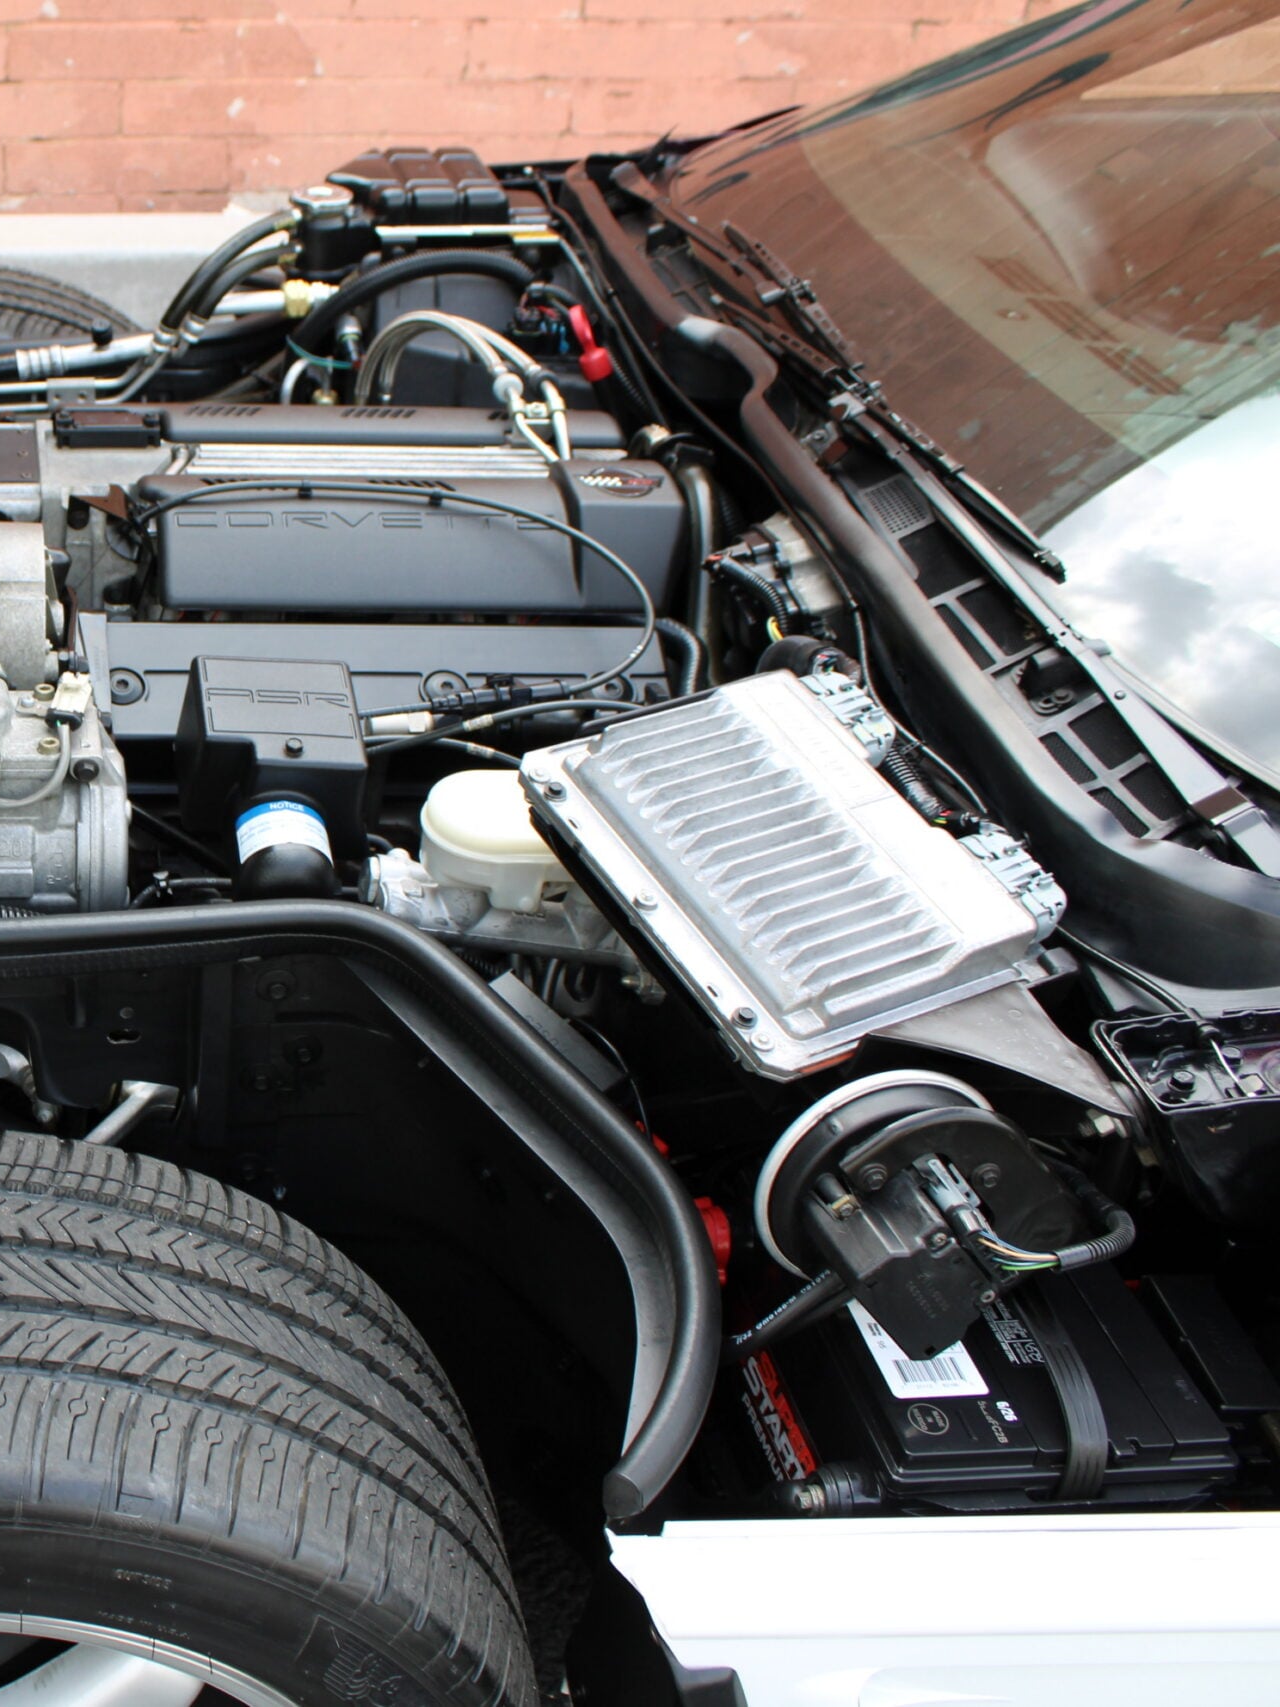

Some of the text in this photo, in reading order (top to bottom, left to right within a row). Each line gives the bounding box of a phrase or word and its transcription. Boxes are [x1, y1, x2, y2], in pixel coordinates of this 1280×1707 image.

[175, 510, 558, 530] CORVETTE
[268, 801, 304, 811] NOTICE
[742, 1356, 806, 1480] START
[759, 1352, 817, 1475] SUPER
[931, 1409, 945, 1428] MADE
